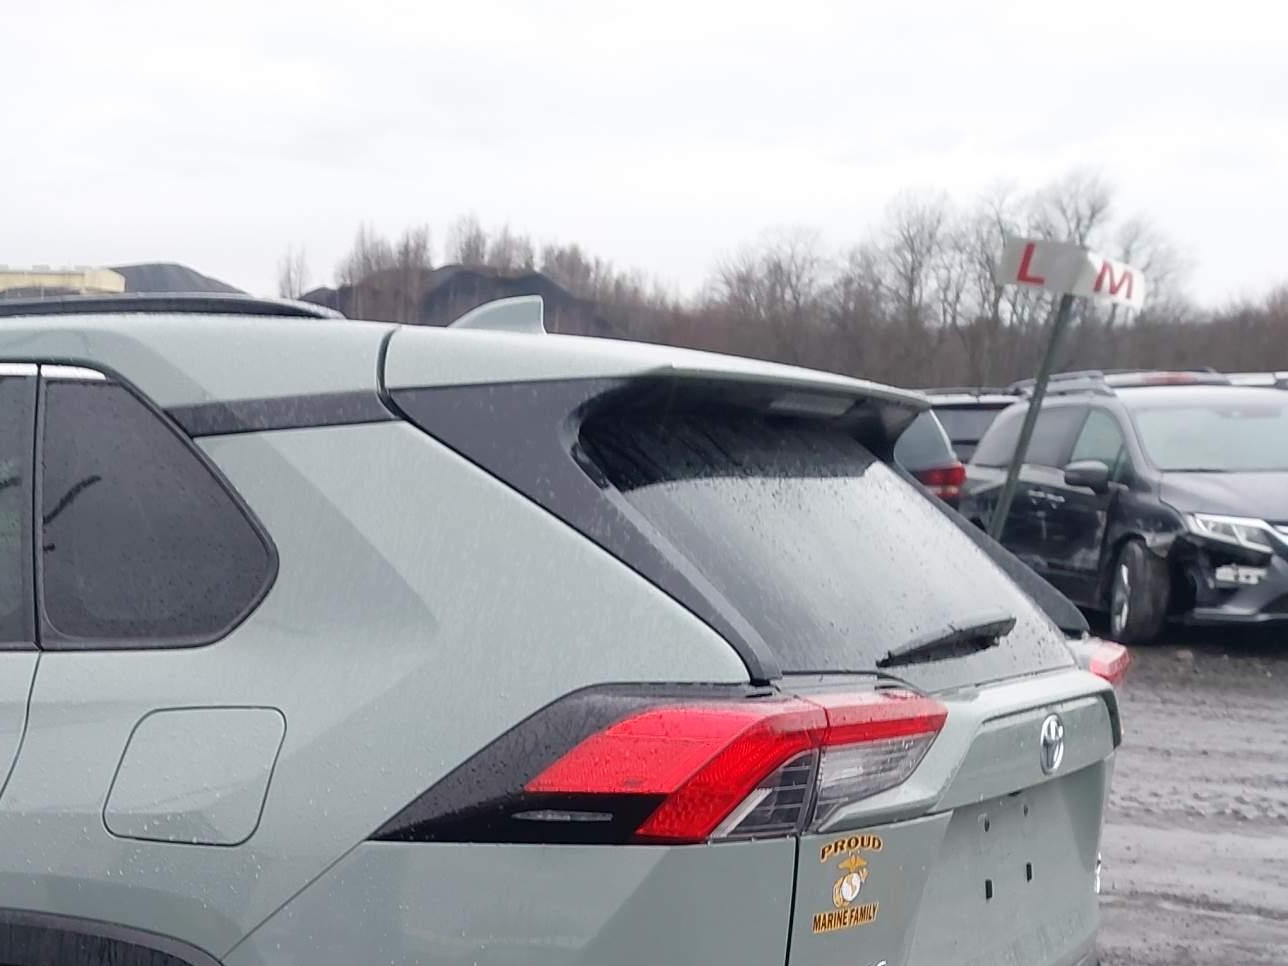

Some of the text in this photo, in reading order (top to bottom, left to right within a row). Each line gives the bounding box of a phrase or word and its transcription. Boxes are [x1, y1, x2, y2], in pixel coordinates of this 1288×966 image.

[1016, 242, 1045, 286] L
[1093, 259, 1133, 300] M
[820, 834, 883, 863] PROUD
[813, 902, 879, 933] MARINE FAMILY
